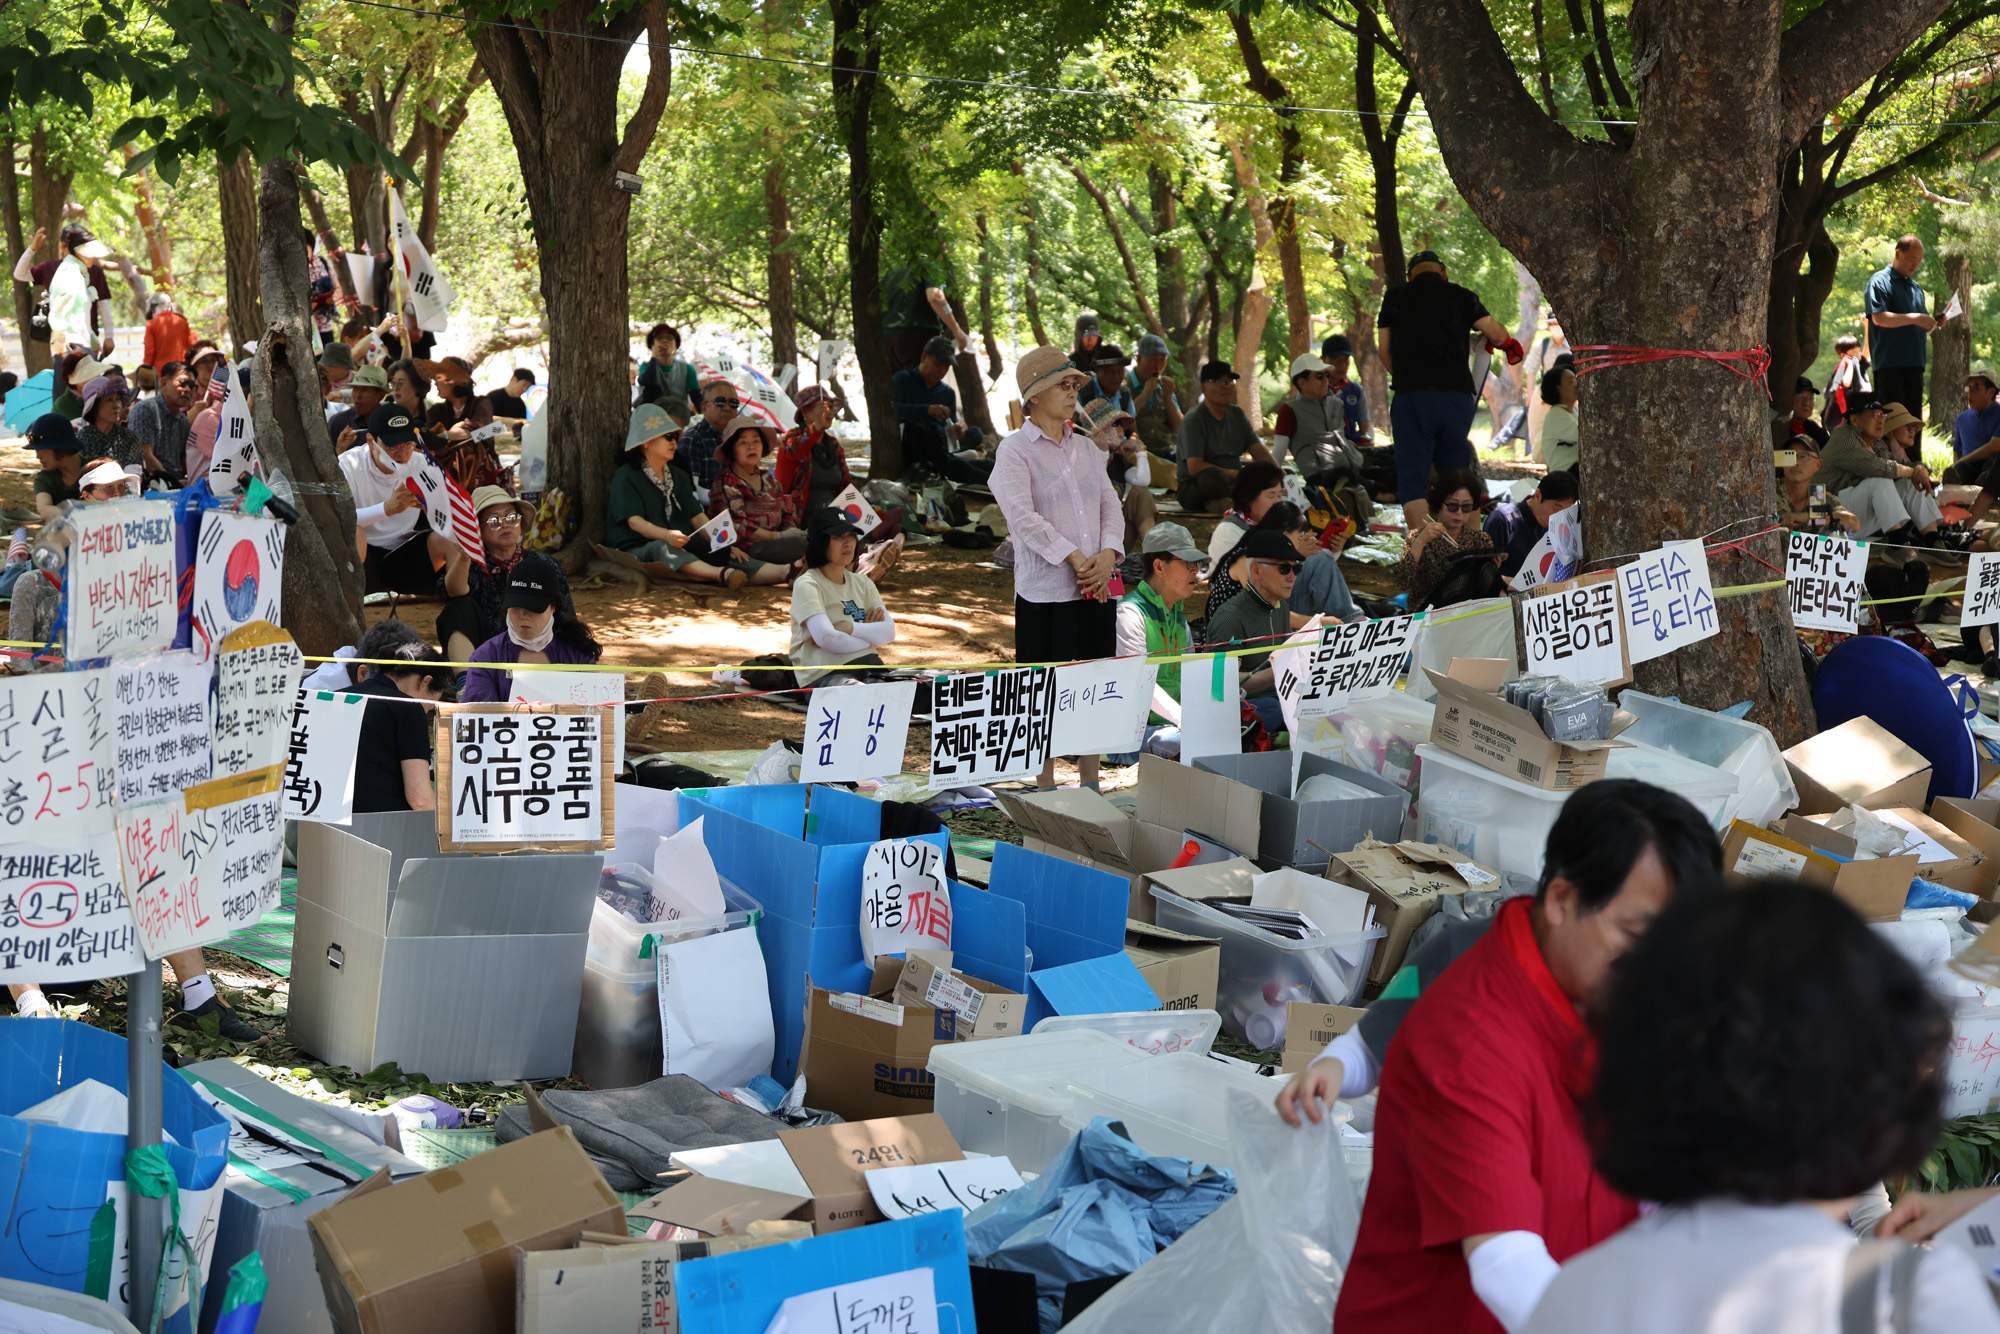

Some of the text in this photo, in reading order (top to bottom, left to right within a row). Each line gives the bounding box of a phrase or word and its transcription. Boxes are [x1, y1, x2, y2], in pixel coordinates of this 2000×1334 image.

[1789, 535, 1851, 578] 우의,우산
[89, 556, 172, 629] 반드시 재선거
[1625, 551, 1691, 626] 물티슈
[1317, 616, 1413, 662] 담요,마스크
[1526, 584, 1614, 661] 생활용품
[116, 673, 135, 705] 이번
[271, 675, 286, 695] 모든
[1058, 681, 1123, 711] 테이프
[117, 711, 143, 741] 국민의
[456, 716, 597, 764] 방호용품
[817, 704, 885, 767] 침낭
[1470, 719, 1481, 728] BABY
[1482, 724, 1495, 735] WIPES
[1568, 713, 1587, 726] EVA
[0, 777, 28, 825] 층
[35, 761, 94, 820] 2-5
[456, 762, 593, 823] 사무용품
[126, 809, 181, 883] 언론에
[182, 809, 218, 874] SNS
[221, 804, 263, 847] 전자투표
[0, 849, 104, 882] 조배터리는
[0, 882, 131, 928] 층 2-5 보급소
[0, 925, 134, 969] 앞에 있습니다!
[838, 1209, 864, 1219] LOTTE
